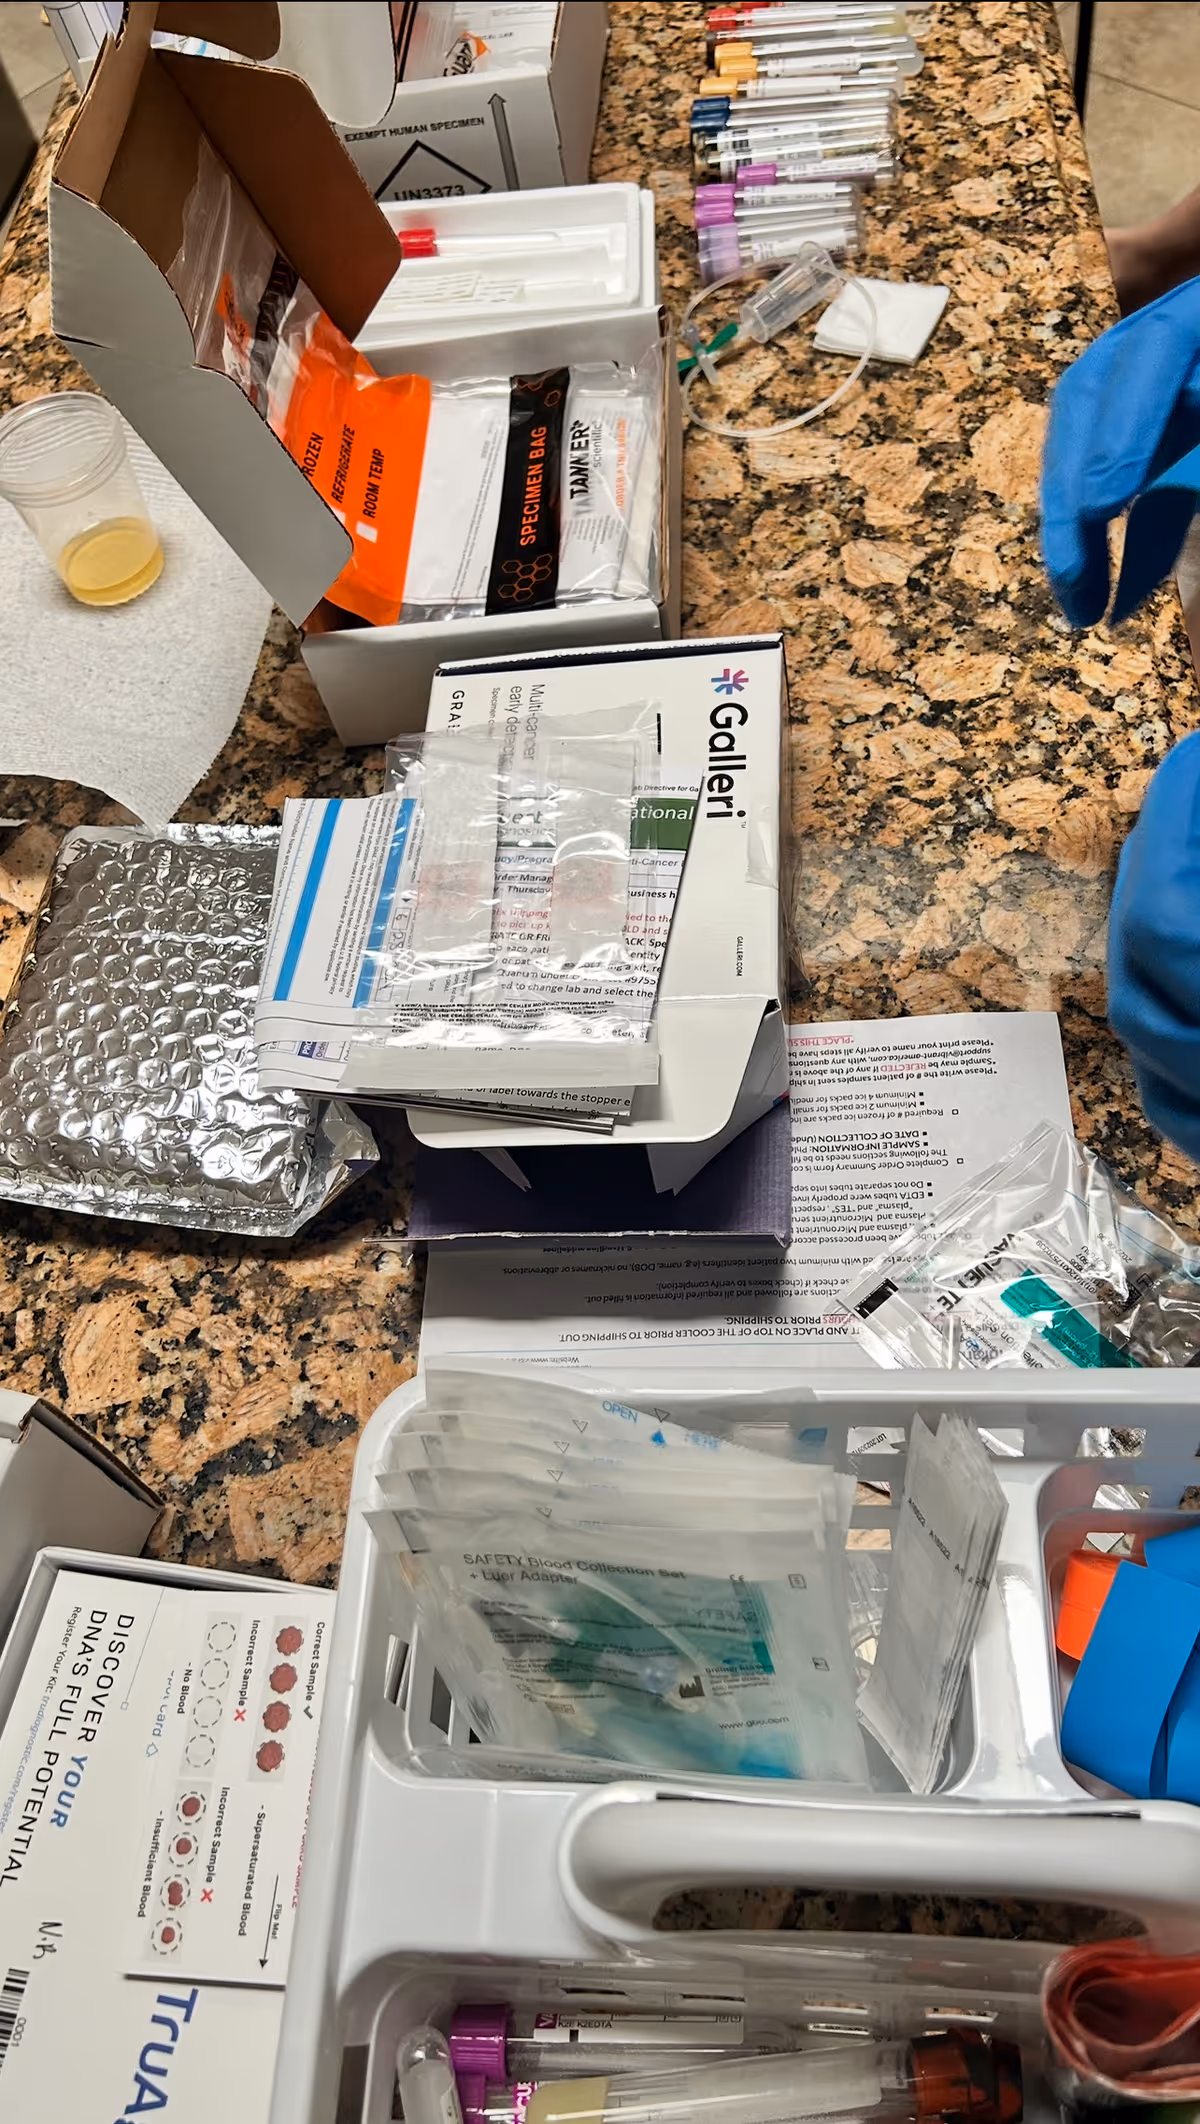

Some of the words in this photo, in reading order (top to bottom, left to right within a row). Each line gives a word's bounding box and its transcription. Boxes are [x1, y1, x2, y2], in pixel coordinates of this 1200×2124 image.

[344, 128, 387, 142] EXEMPT
[389, 123, 428, 138] HUMAN
[430, 116, 485, 132] SPECIMEN
[394, 184, 465, 200] UN3373
[528, 426, 547, 458] BAG
[302, 432, 324, 477] ROZEN
[331, 424, 355, 503] REFRIGERATE
[369, 448, 384, 480] TEMP
[569, 426, 589, 499] TANNER
[363, 482, 380, 518] ROOM
[520, 463, 545, 546] SPECIMEN
[489, 687, 501, 718] Specimen
[504, 686, 523, 713] early
[523, 684, 546, 760] Multi-cancer
[707, 703, 748, 819] Galleri
[630, 858, 679, 867] ti-Cancer
[631, 952, 660, 961] entity
[735, 936, 744, 977] GALLERI.COM
[528, 984, 563, 994] change
[565, 985, 581, 993] lab
[583, 986, 601, 995] and
[604, 988, 633, 997] select
[636, 989, 653, 998] the
[802, 1038, 819, 1047] THIS
[892, 1043, 916, 1051] name
[917, 1041, 937, 1050] your
[938, 1039, 960, 1049] print
[799, 1050, 818, 1058] have
[820, 1048, 842, 1057] steps
[844, 1048, 854, 1056] all
[855, 1044, 880, 1054] verify
[868, 1047, 991, 1063] support@vibrant-america.com,
[831, 1056, 846, 1066] any
[847, 1056, 866, 1065] with
[928, 1061, 938, 1069] be
[940, 1059, 958, 1067] may
[829, 1068, 842, 1076] the
[844, 1067, 854, 1075] of
[855, 1064, 871, 1073] any
[880, 1062, 926, 1072] REJECTED
[803, 1069, 828, 1077] above
[873, 1072, 903, 1082] patient
[905, 1072, 914, 1081] of
[924, 1071, 938, 1079] the
[939, 1069, 963, 1077] write
[837, 1074, 871, 1084] samples
[516, 1088, 558, 1100] towards
[561, 1091, 578, 1101] the
[581, 1092, 622, 1106] stopper
[816, 1105, 828, 1114] for
[830, 1102, 855, 1113] packs
[856, 1103, 867, 1111] ice
[876, 1101, 916, 1109] Minimum
[793, 1107, 814, 1115] small
[886, 1111, 895, 1120] of
[904, 1108, 943, 1118] Required
[818, 1113, 842, 1124] packs
[857, 1112, 884, 1121] frozen
[818, 1132, 878, 1142] COLLECTION
[880, 1132, 893, 1140] OF
[894, 1130, 919, 1139] DATE
[809, 1142, 880, 1154] INFORMATION:
[882, 1140, 920, 1150] SAMPLE
[826, 1153, 851, 1163] needs
[853, 1152, 887, 1161] sections
[888, 1149, 929, 1160] following
[930, 1149, 947, 1157] The
[803, 1156, 813, 1165] be
[815, 1156, 824, 1164] to
[724, 1317, 773, 1325] SHIPPING.
[775, 1317, 788, 1325] TO
[790, 1316, 821, 1324] PRIOR
[644, 1330, 673, 1338] PRIOR
[676, 1329, 715, 1339] COOLER
[717, 1329, 736, 1337] THE
[738, 1328, 750, 1337] OF
[753, 1328, 773, 1337] TOP
[775, 1328, 791, 1336] ON
[793, 1328, 824, 1336] PLACE
[826, 1327, 848, 1335] AND
[558, 1334, 580, 1343] OUT.
[582, 1332, 627, 1341] SHIPPING
[601, 1399, 638, 1423] OPEN
[464, 1553, 522, 1567] SAFETY
[528, 1557, 572, 1570] Blood
[576, 1560, 655, 1577] Collection
[657, 1568, 686, 1579] Set
[521, 1570, 579, 1584] Adapter
[61, 1606, 82, 1648] Register
[245, 1620, 261, 1666] Incorrect
[311, 1622, 325, 1660] Correct
[51, 1650, 67, 1674] Your
[77, 1614, 135, 1743] DISCOVER
[183, 1669, 193, 1683] No
[44, 1676, 59, 1694] Kit:
[304, 1662, 319, 1701] Sample
[238, 1668, 252, 1707] Sample
[177, 1685, 189, 1714] Blood
[48, 1684, 82, 1741] FULL
[49, 1755, 89, 1829] YOUR
[213, 1787, 230, 1838] Incorrect
[0, 1750, 60, 1888] POTENTIAL
[144, 1818, 164, 1882] Insufficient
[244, 1812, 266, 1900] Supersaturated
[205, 1840, 221, 1883] Sample
[137, 1884, 151, 1918] Blood
[272, 1904, 282, 1920] Flip
[238, 1903, 251, 1937] Blood
[271, 1922, 280, 1940] Me!
